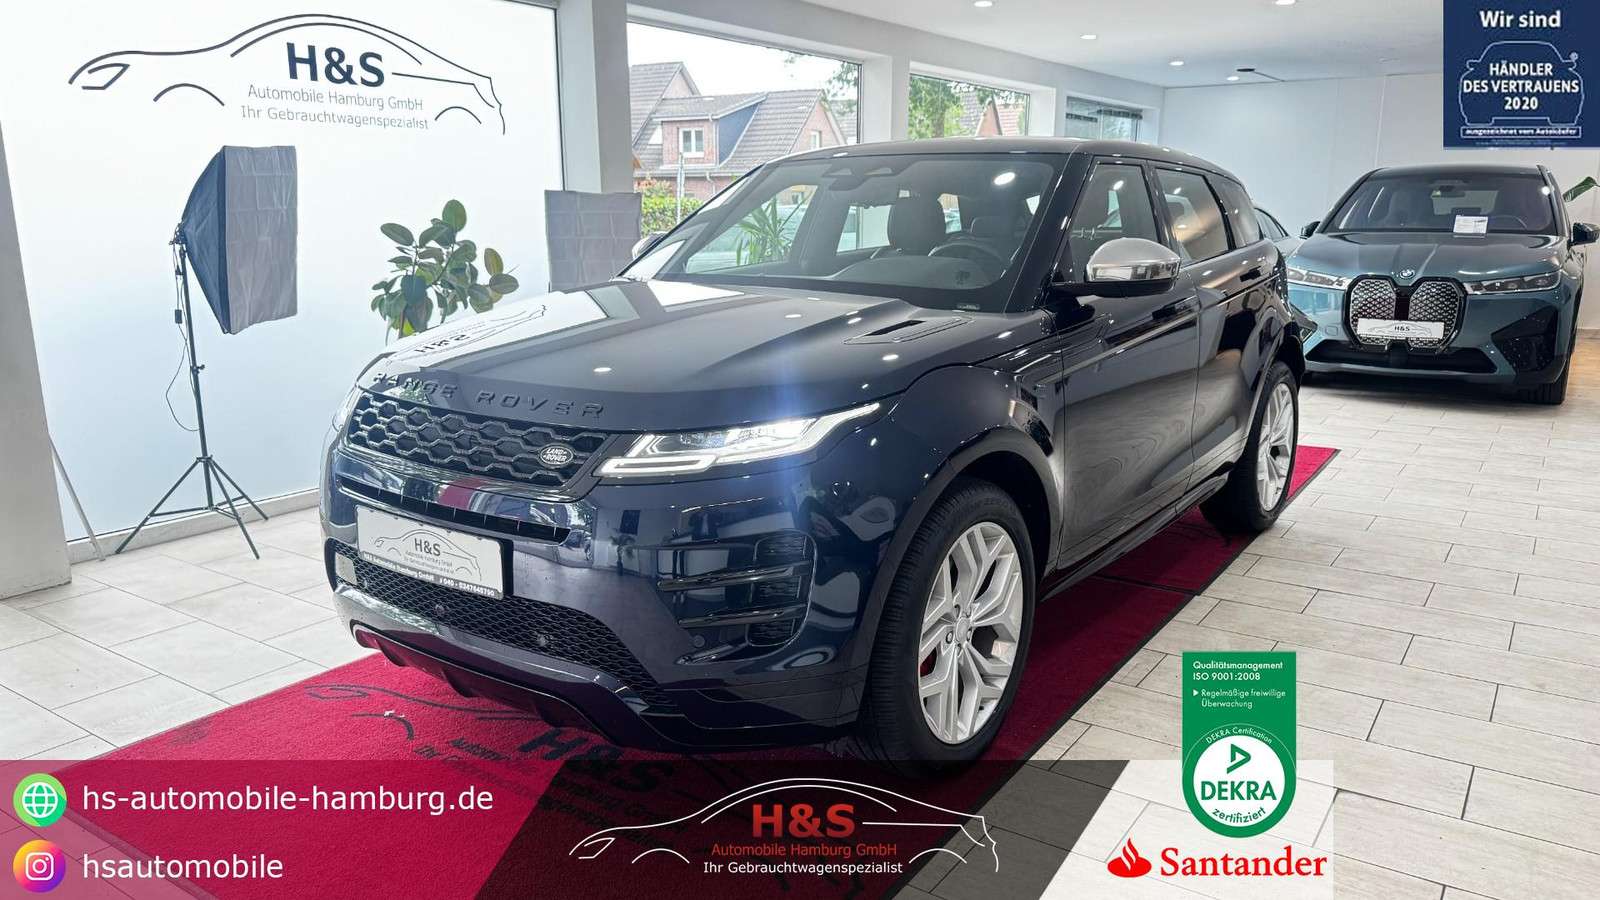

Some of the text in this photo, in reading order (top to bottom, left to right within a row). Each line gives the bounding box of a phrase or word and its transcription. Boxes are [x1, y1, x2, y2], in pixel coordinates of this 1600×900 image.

[286, 41, 386, 88] H&S
[248, 84, 424, 111] Automobile Hamburg GmbH
[240, 105, 430, 131] Ihr Gebrauchtwagenspezialist
[372, 372, 606, 420] RANGE ROVER
[414, 537, 441, 557] H&S
